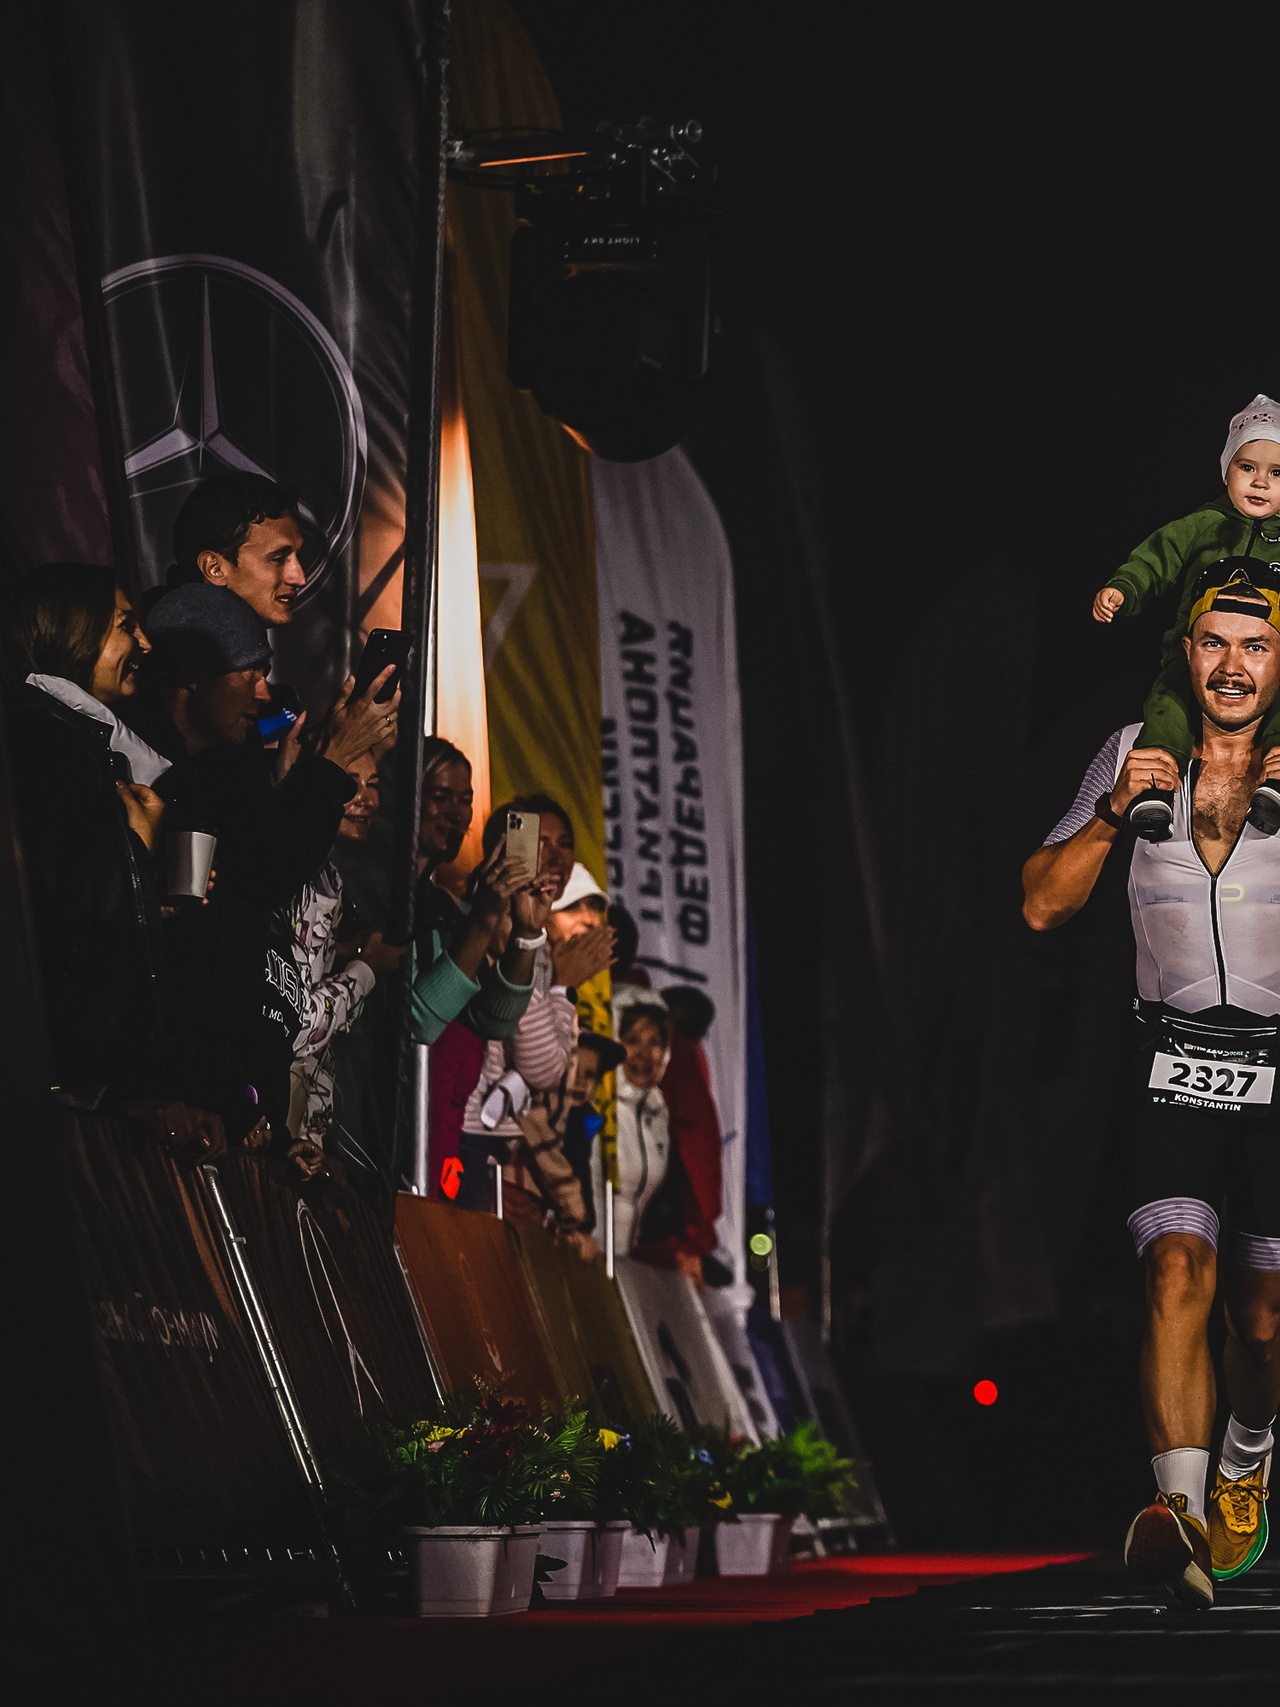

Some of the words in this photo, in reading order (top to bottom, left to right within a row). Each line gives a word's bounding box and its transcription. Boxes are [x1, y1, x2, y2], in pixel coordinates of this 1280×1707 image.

[583, 236, 604, 244] SKY
[608, 236, 640, 244] LIGHT
[1168, 1062, 1258, 1097] 2327
[1174, 1093, 1242, 1112] KONSTANTIN
